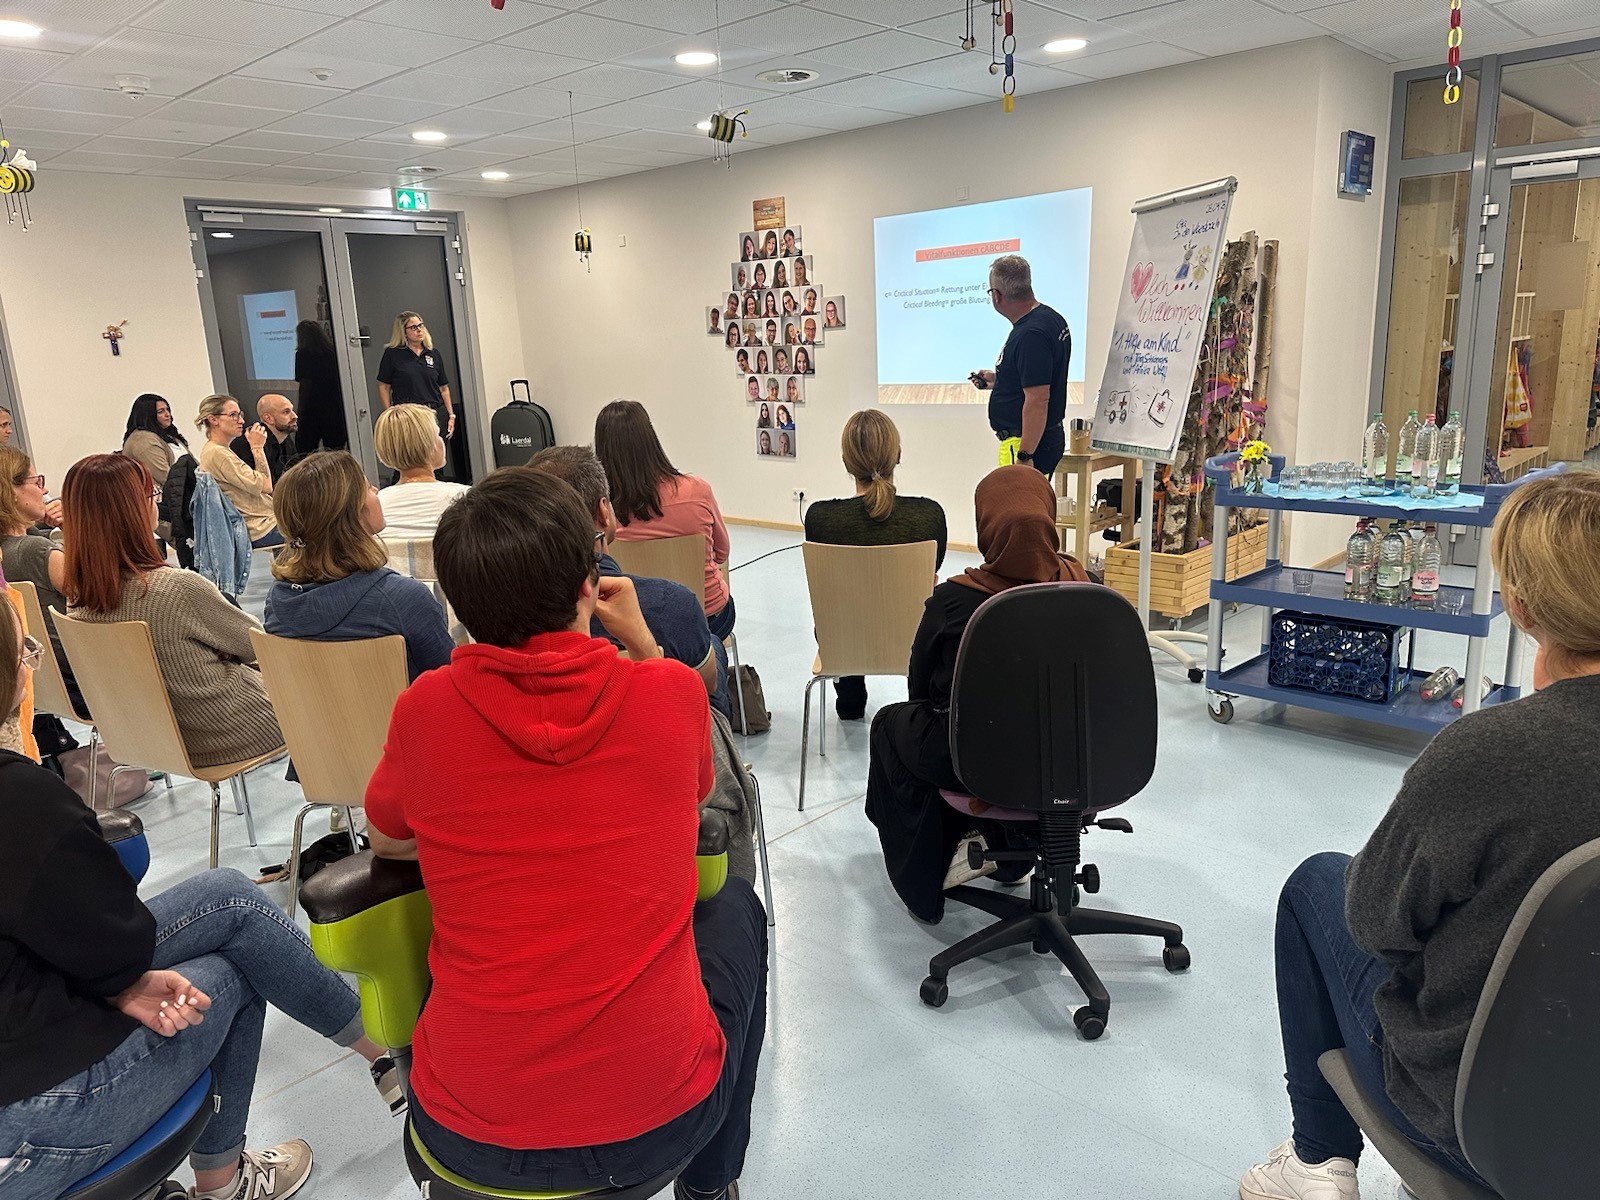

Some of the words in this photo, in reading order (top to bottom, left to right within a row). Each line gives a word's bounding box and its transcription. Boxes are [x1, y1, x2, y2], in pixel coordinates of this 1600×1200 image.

[925, 247, 979, 260] Vitalfunktionen
[980, 242, 1010, 254] cABCDE
[941, 285, 964, 294] Rettung
[964, 284, 981, 292] unter
[511, 436, 532, 444] Laerdal
[1327, 1167, 1356, 1179] Reebo
[252, 1167, 276, 1200] N
